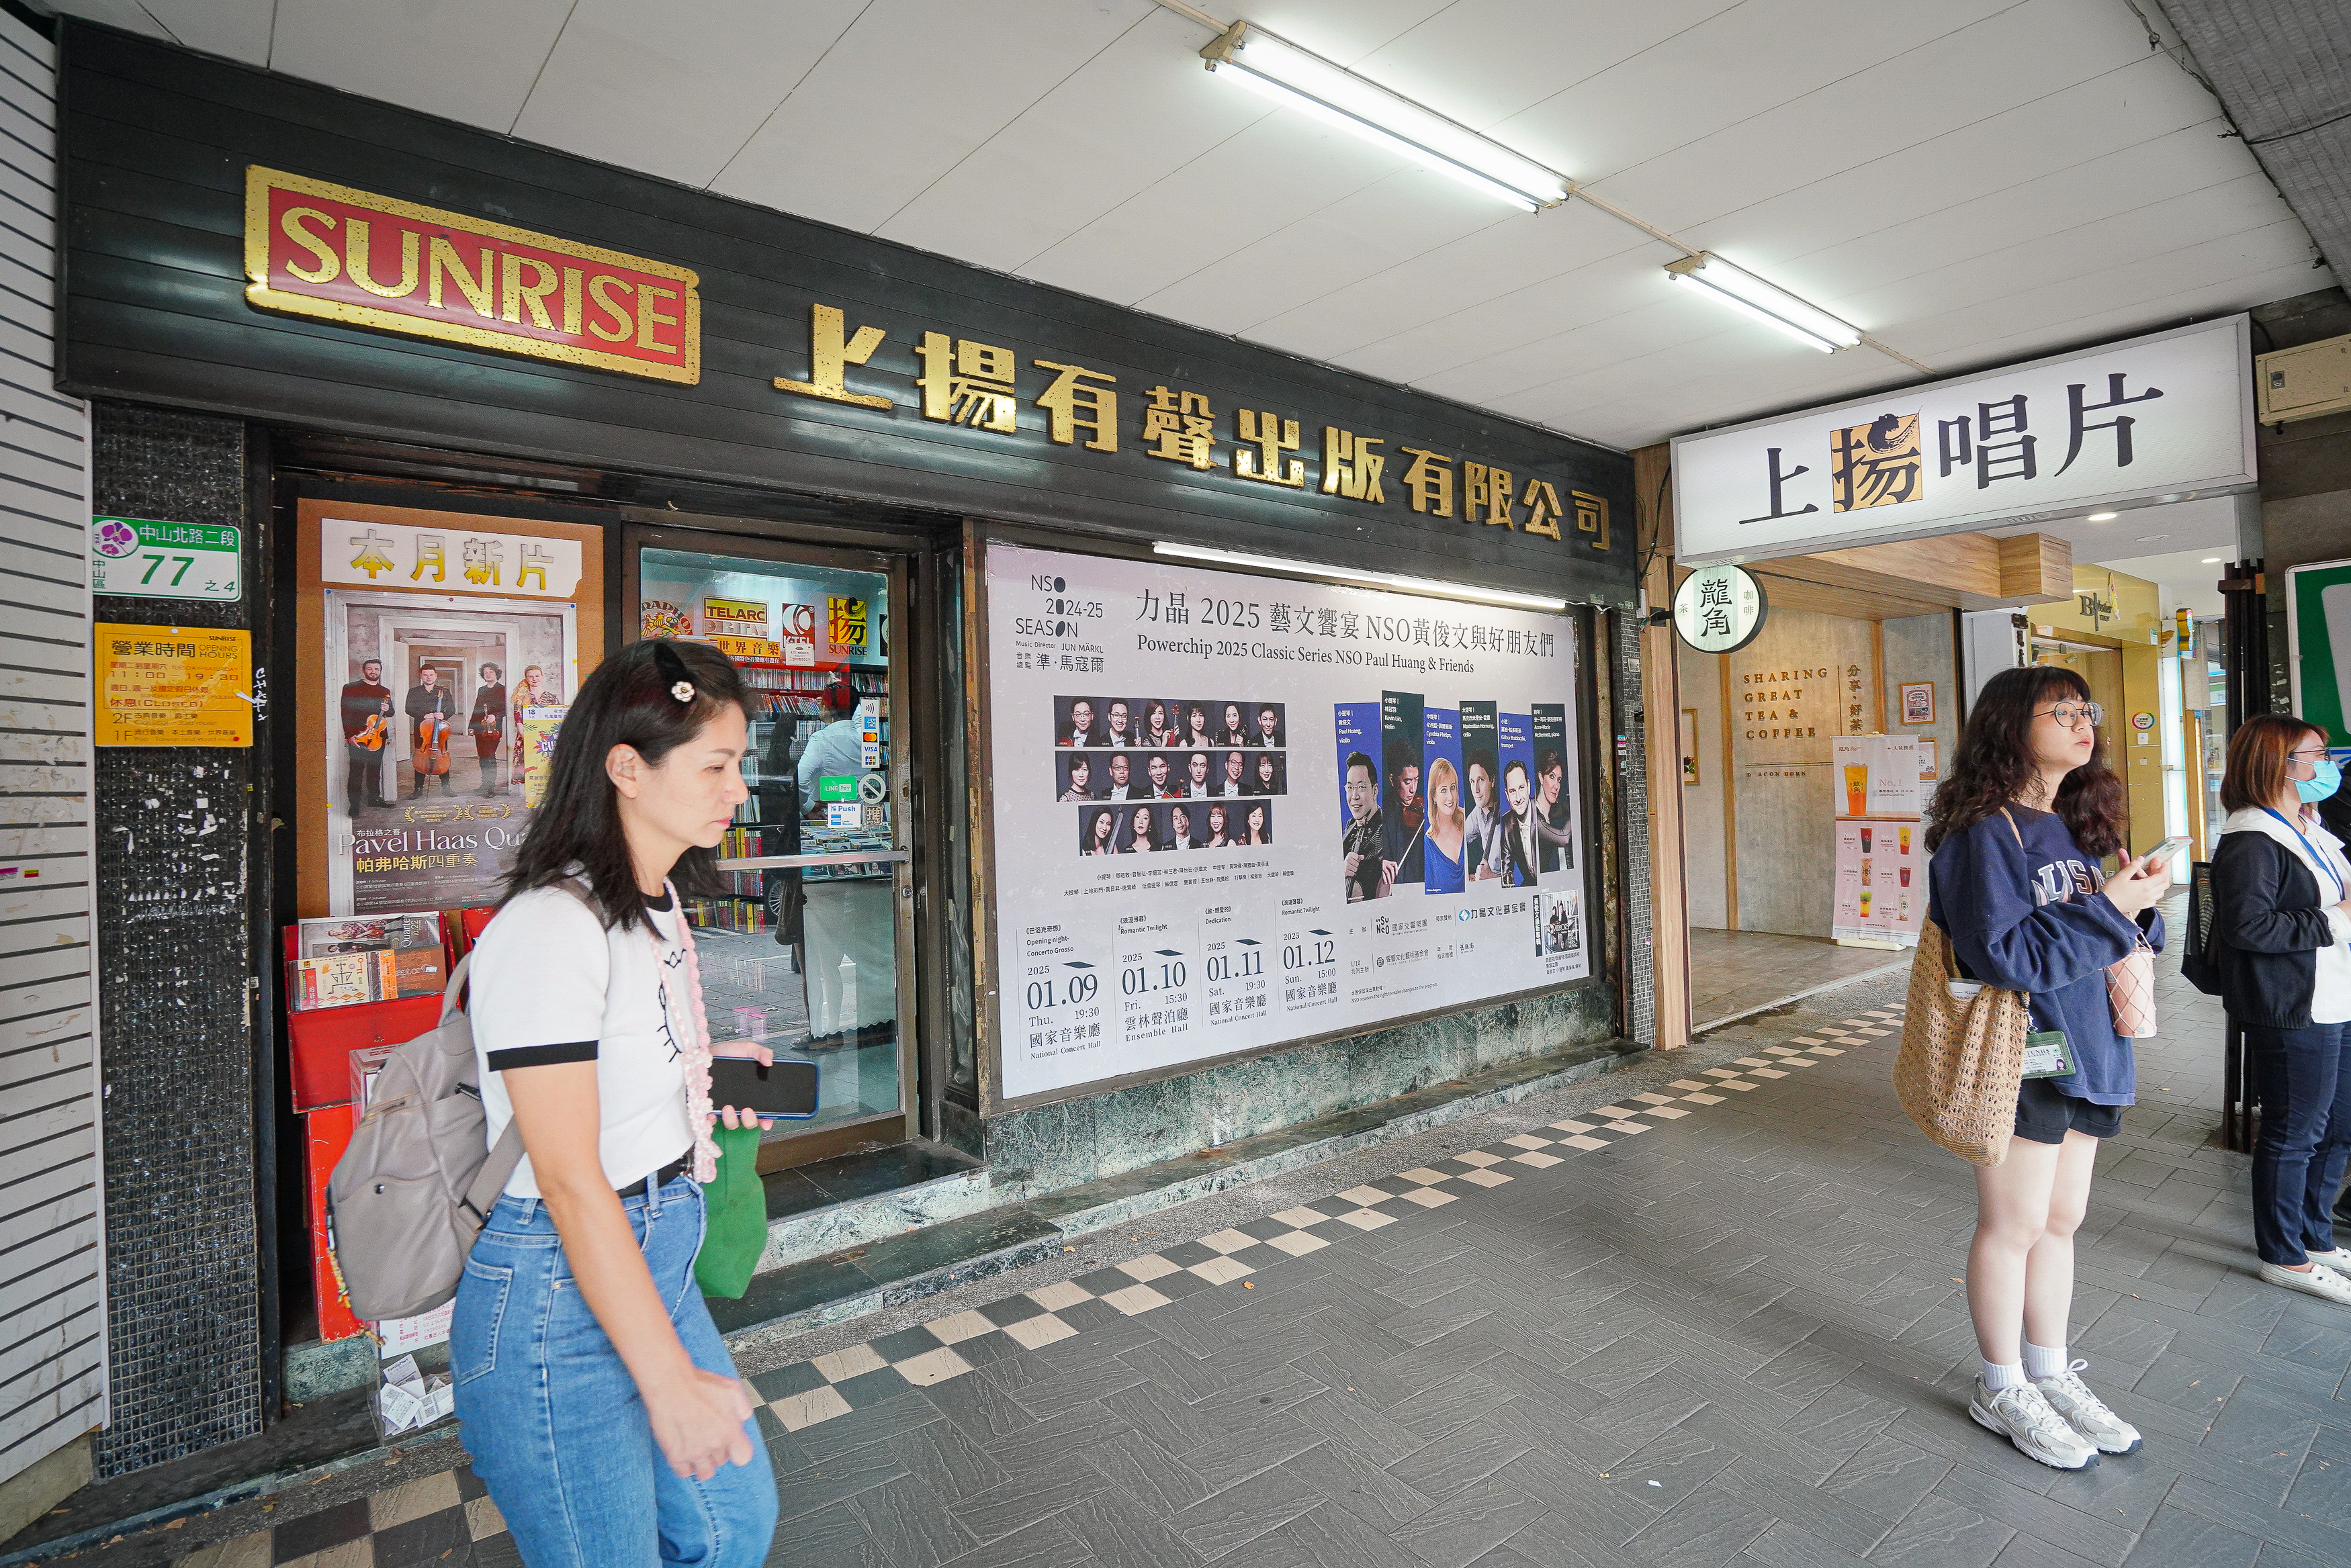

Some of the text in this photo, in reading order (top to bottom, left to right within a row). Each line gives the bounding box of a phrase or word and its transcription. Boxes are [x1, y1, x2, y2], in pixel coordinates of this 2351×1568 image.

[281, 206, 678, 354] SUNRISE
[773, 303, 1610, 550] 上揚有聲出版有限公司
[1738, 373, 2164, 524] 上揚唱片
[139, 524, 235, 547] 中山北路二段
[350, 528, 554, 590] 本月新片
[93, 559, 105, 588] 中山區
[140, 554, 195, 586] 77
[1032, 574, 1066, 593] NSO
[707, 606, 765, 622] TELARC
[1046, 598, 1103, 618] 2024-25
[1136, 588, 1189, 625] 力晶
[1200, 598, 1260, 629] 2025
[1270, 602, 1359, 640] 藝文饗宴
[1679, 603, 1688, 614] 茶
[1700, 579, 1732, 637] 龍角
[705, 620, 768, 636] DIGITAL
[1016, 618, 1078, 638] SEASON
[112, 640, 195, 657] 營業時間
[199, 644, 238, 652] OPENING
[829, 644, 868, 656] SUNRISE
[1061, 643, 1076, 651] JUN
[1078, 643, 1104, 653] MÄRKL
[1137, 634, 1474, 674] Powerchip 2025 Classic Series NSO Paul Huang & Friends
[1744, 667, 1828, 684] SHARING
[1744, 689, 1803, 703] GREAT
[112, 712, 132, 724] 2F
[1745, 709, 1798, 721] TEA &
[114, 730, 133, 741] 1F
[1746, 727, 1816, 739] COFFEE
[357, 829, 401, 837] 布拉格之春
[338, 829, 478, 856] Pavel Haas
[356, 853, 479, 873] 帕弗哈斯四重奏
[1471, 902, 1525, 919] 力晶文化基金會
[1026, 924, 1062, 935] 《巴洛克奇想》
[1120, 924, 1167, 935] Romantic Twilight
[1205, 917, 1231, 925] Dedication
[1026, 938, 1051, 946] Opening
[1283, 932, 1300, 941] 2025
[1026, 946, 1074, 957] Concerto Grosso
[1207, 942, 1225, 952] 2025
[1283, 940, 1335, 970] 01.12
[1122, 953, 1143, 963] 2025
[1207, 950, 1264, 981] 01.11
[1028, 966, 1050, 976] 2025
[1122, 962, 1186, 995] 01.10
[1285, 968, 1336, 984] Sun. 15:00
[1027, 974, 1098, 1010] 01.09
[1209, 980, 1266, 997] Sat. 19:30
[1286, 981, 1337, 1003] 國家音樂廳
[1124, 993, 1188, 1011] Fri. 15:30
[1210, 993, 1267, 1016] 國家音樂廳
[1287, 1002, 1307, 1012] National
[1308, 999, 1327, 1008] Concert
[1029, 1007, 1100, 1027] Thu. 19:30
[1124, 1007, 1188, 1031] 雲林聲泊廳
[1210, 1010, 1267, 1026] National Concert Hall
[1030, 1023, 1100, 1048] 國家音樂廳
[1126, 1023, 1188, 1042] Ensemble Hall
[1030, 1041, 1101, 1060] National Concert Hall
